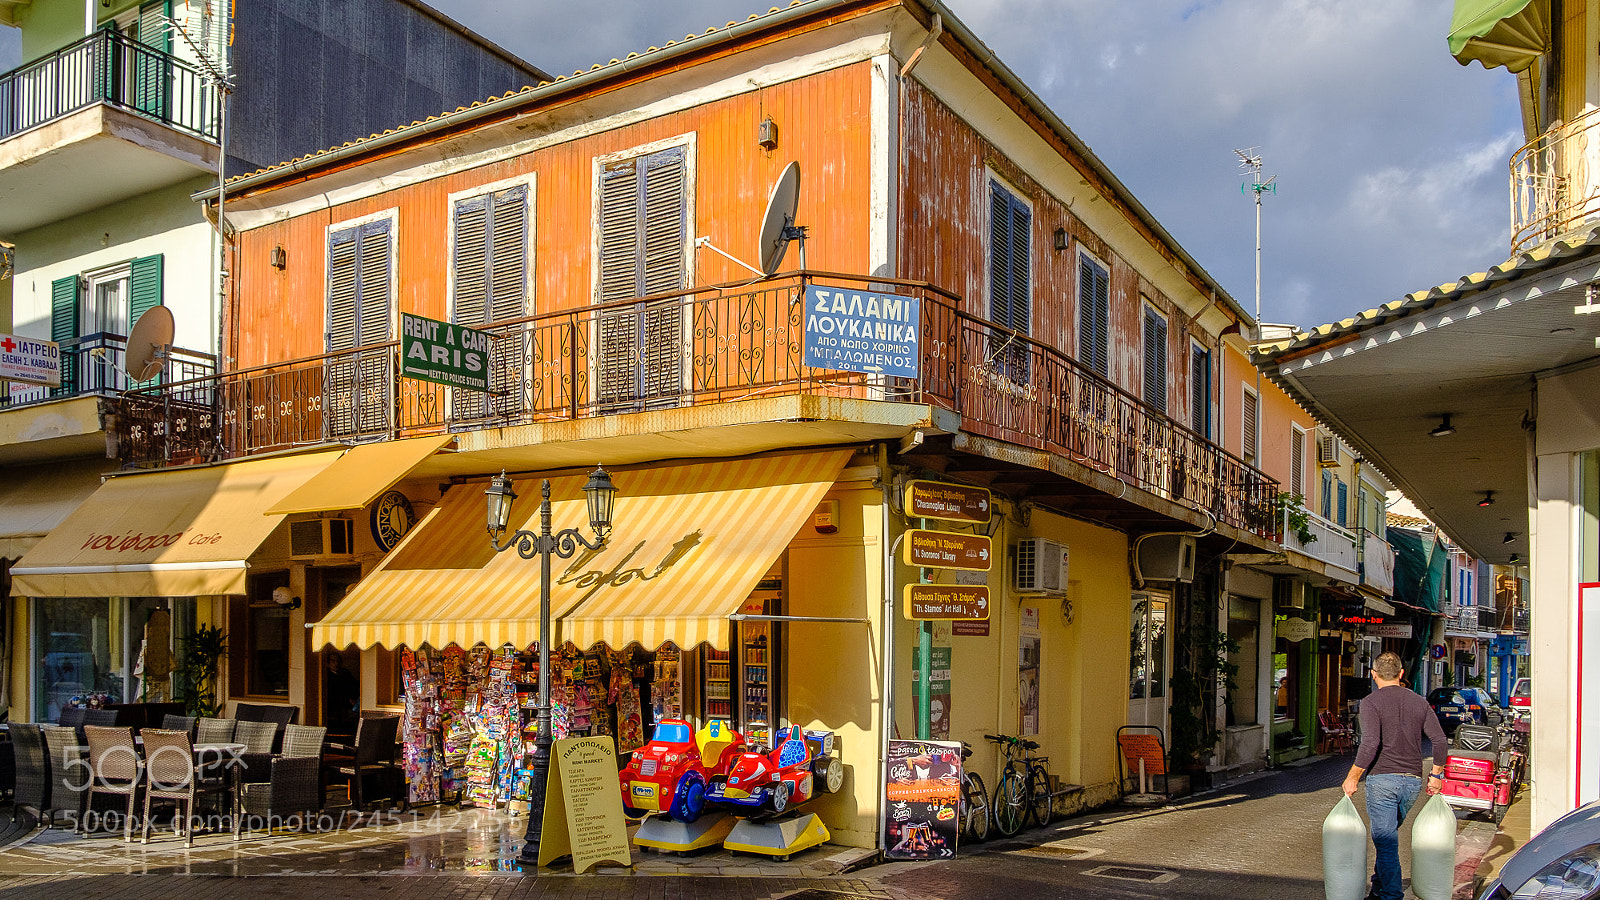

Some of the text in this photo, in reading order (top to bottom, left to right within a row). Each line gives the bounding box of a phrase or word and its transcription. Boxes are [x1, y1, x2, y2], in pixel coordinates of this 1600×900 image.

[815, 291, 910, 322] ΣΑΛΑΜΙ
[404, 315, 486, 352] RENT A CAR
[807, 314, 917, 343] ΛΟΥΚΑΝΙΚΑ
[19, 341, 58, 358] ΙΑΤΡΕΙΟ
[818, 336, 838, 347] ΑΠΟ
[840, 338, 869, 350] ΝΩΠΟ
[2, 354, 58, 370] ΕΛΕΝΗ Σ. ΚΑΒΒΑΔΑ
[407, 340, 482, 372] ARIS
[428, 369, 485, 388] NEXT TO POLICE STATION
[946, 502, 961, 514] Library
[942, 551, 957, 563] Library
[952, 605, 962, 613] Hall
[563, 741, 612, 759] ΠΑΝΤΟΠΩΛΕΙΟ
